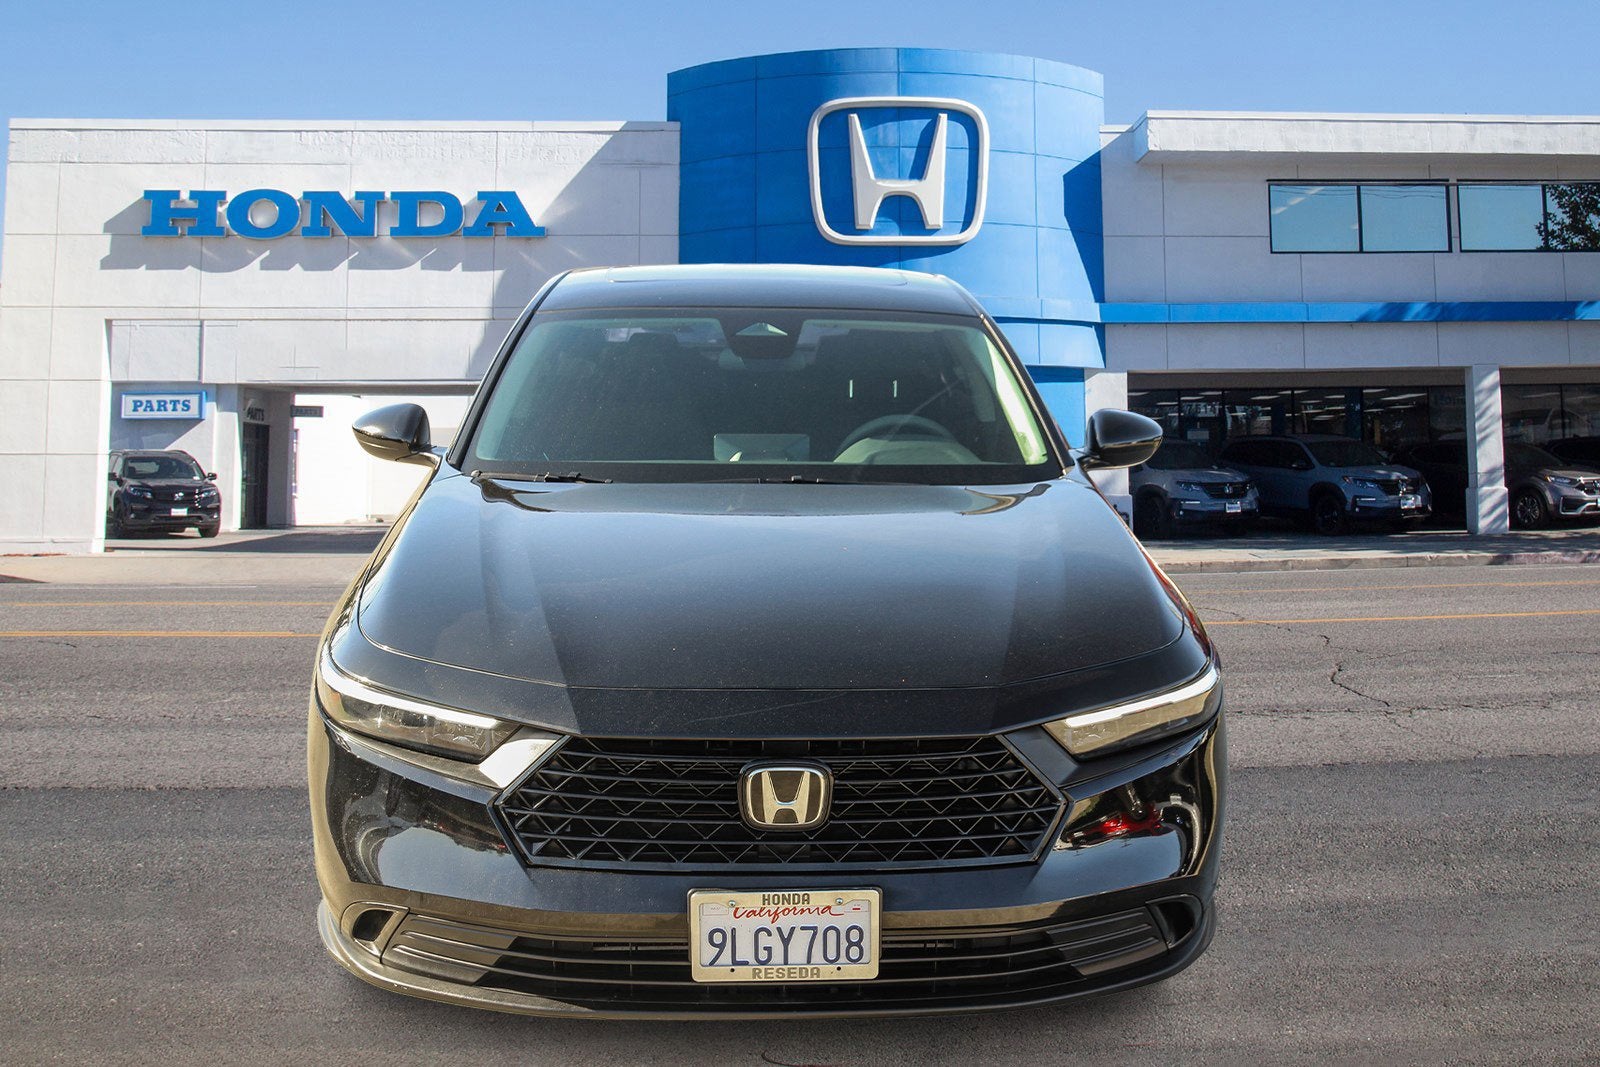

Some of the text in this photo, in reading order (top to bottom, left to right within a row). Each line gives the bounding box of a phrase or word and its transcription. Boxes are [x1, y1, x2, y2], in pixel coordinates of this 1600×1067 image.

[141, 188, 547, 239] HONDA
[131, 399, 192, 412] PARTS
[762, 893, 811, 906] HONDA
[733, 905, 845, 924] California
[708, 924, 864, 966] 9LGY708
[752, 967, 821, 980] RESEDA
